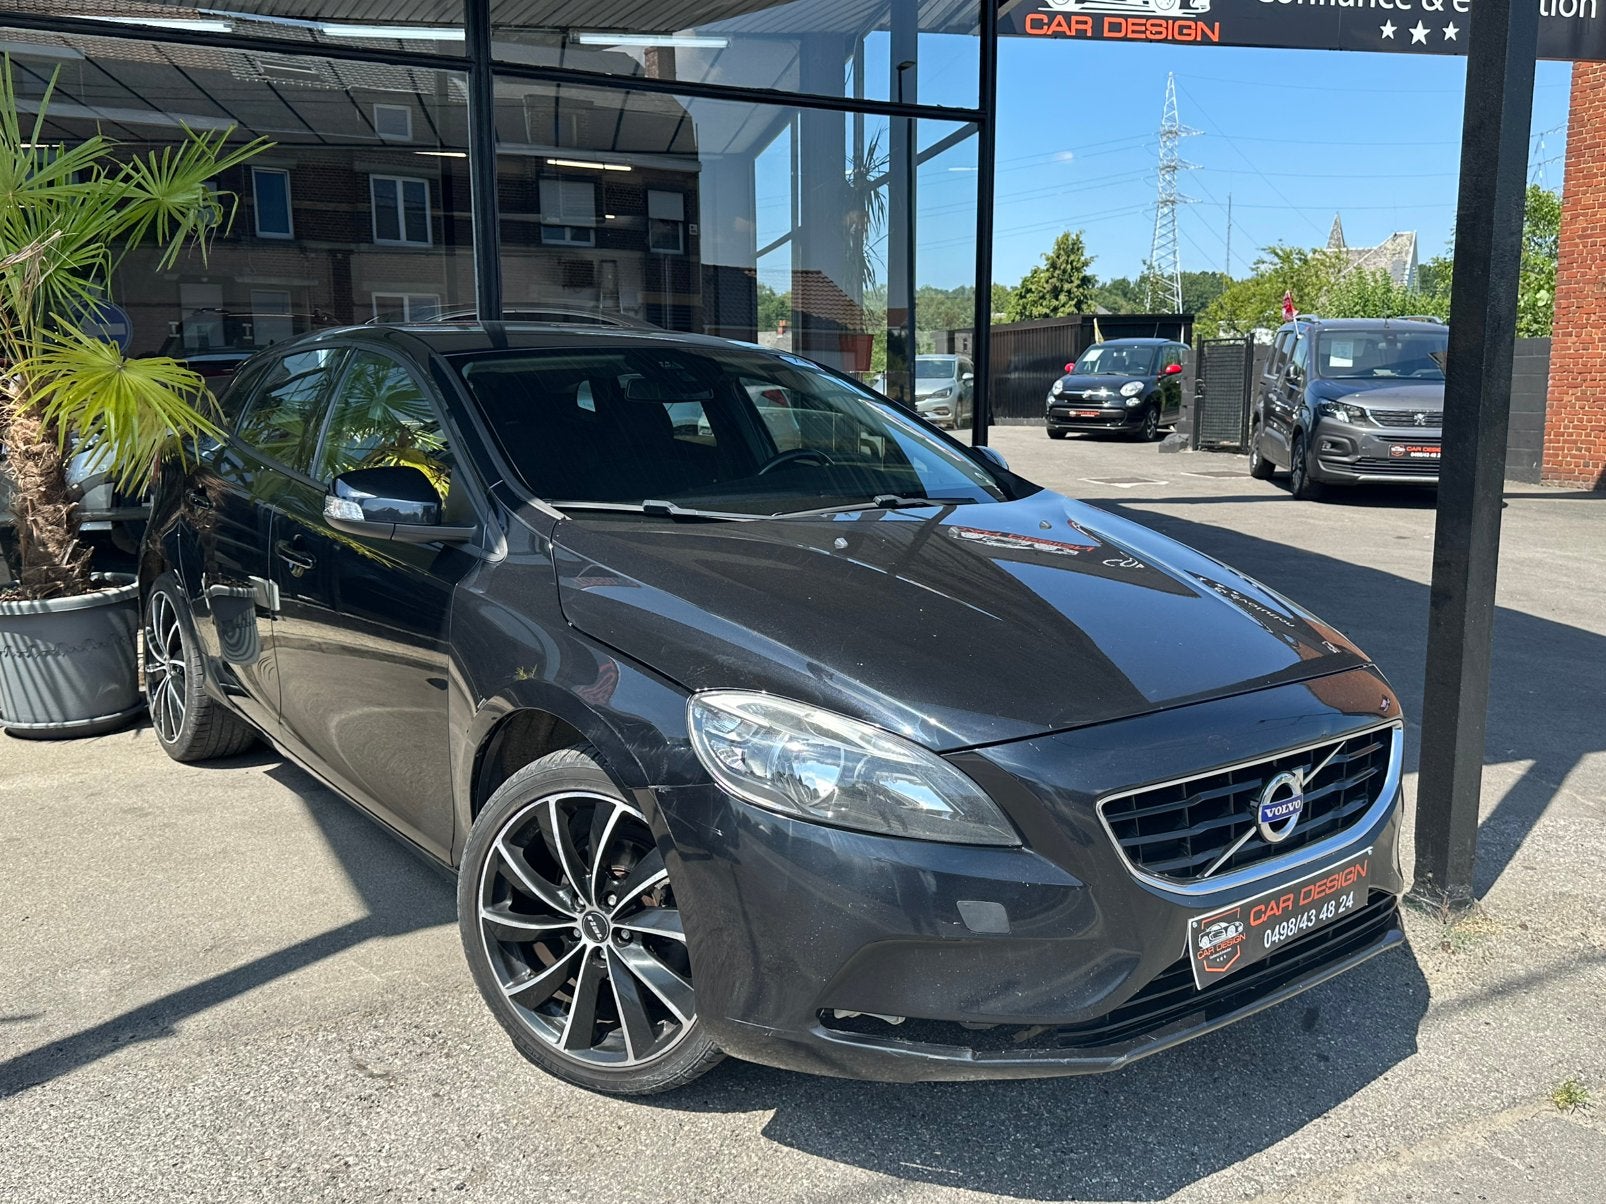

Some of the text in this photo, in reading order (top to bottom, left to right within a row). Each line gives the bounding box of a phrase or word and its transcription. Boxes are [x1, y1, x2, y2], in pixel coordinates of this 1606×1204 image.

[1025, 13, 1220, 42] CAR DESIGN
[1264, 800, 1301, 818] VOLVO
[1250, 859, 1368, 927] CAR DESIGN
[1263, 891, 1354, 949] 0498/43 48 24
[1197, 947, 1215, 960] CAR
[1216, 933, 1246, 952] DESIGN
